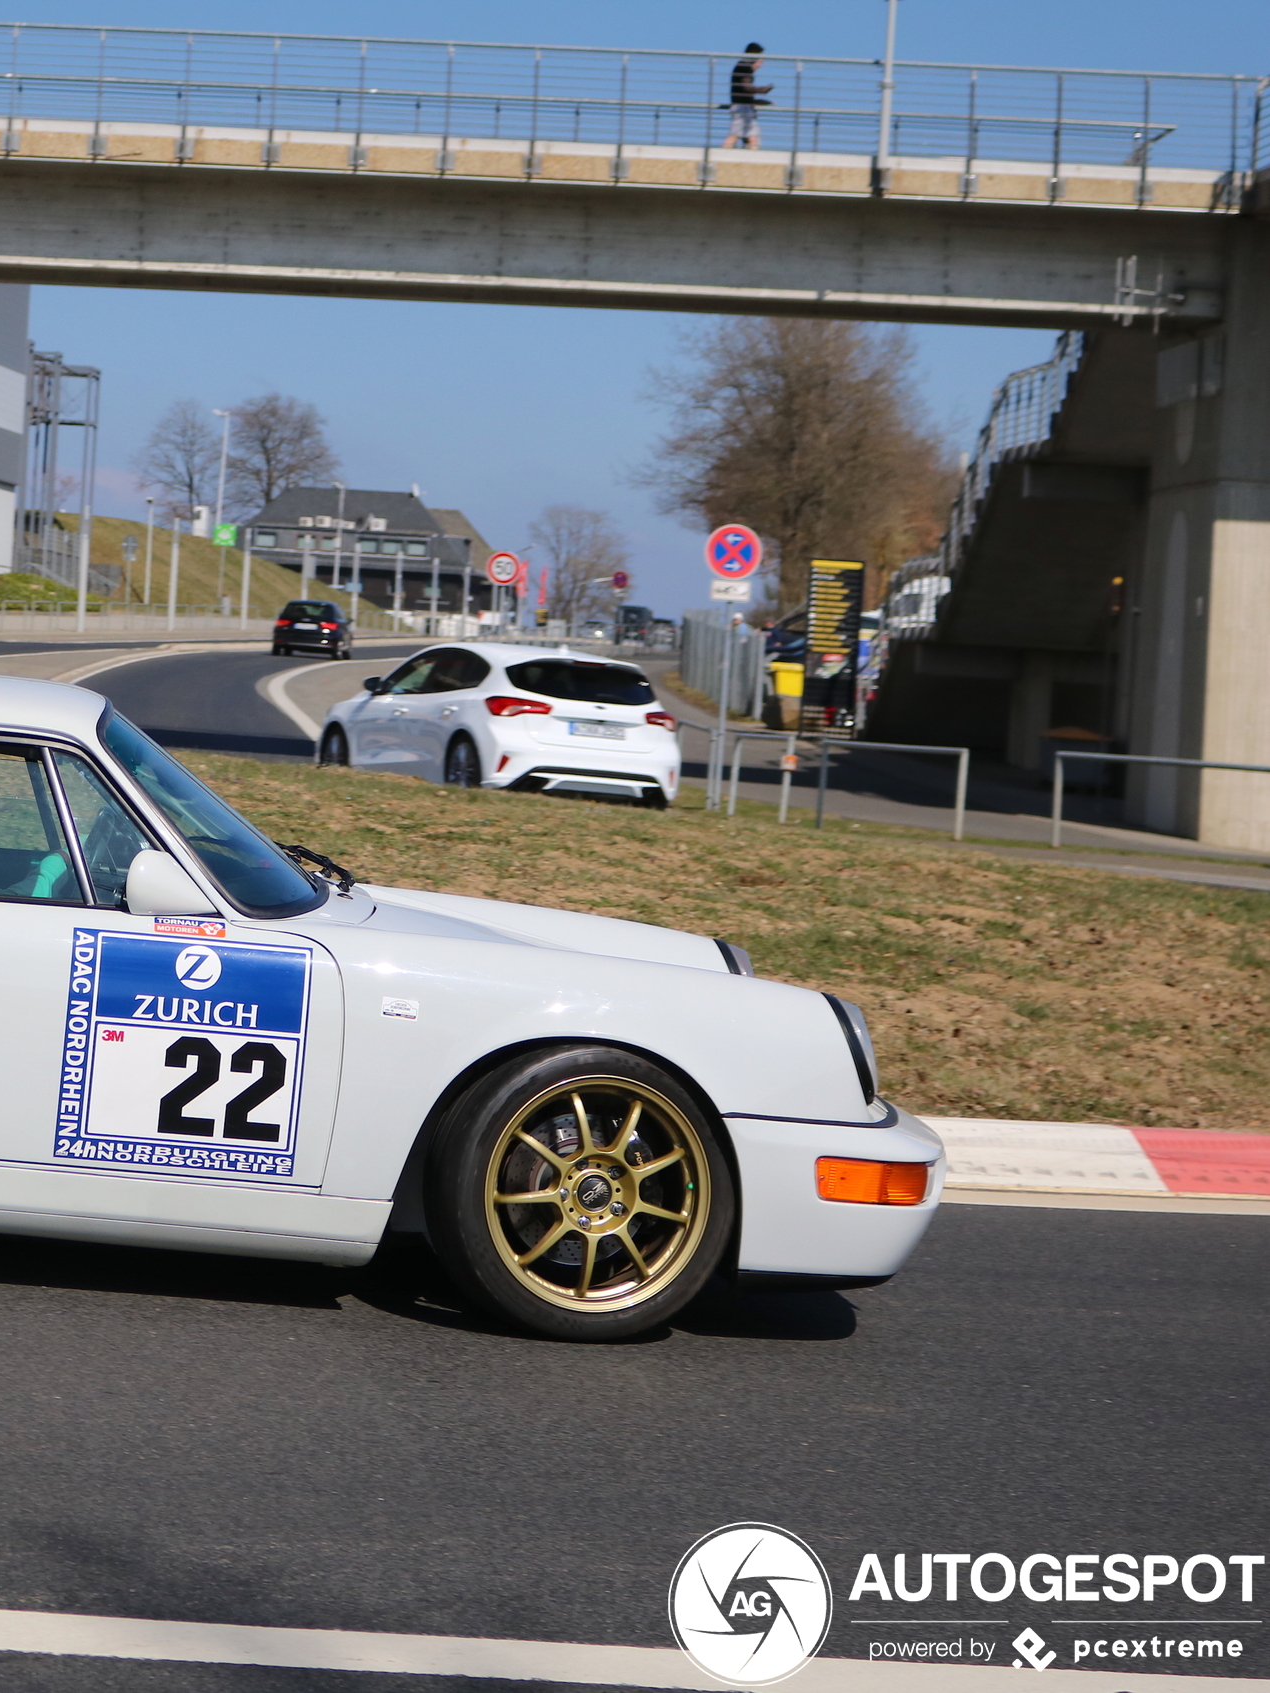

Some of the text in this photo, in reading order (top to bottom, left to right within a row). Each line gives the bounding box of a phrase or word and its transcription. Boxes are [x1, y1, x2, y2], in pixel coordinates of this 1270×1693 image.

[496, 561, 513, 575] 50
[156, 925, 199, 934] MOTOREN
[157, 918, 199, 927] TORNAU
[72, 930, 95, 994] ADAC
[180, 953, 215, 984] Z
[131, 994, 259, 1028] ZURICH
[101, 1029, 125, 1043] 3M
[58, 1000, 90, 1138] NORDRHEIN
[157, 1036, 287, 1142] 22
[55, 1138, 97, 1159] 24h
[96, 1150, 292, 1175] NORDSCHLEIFE
